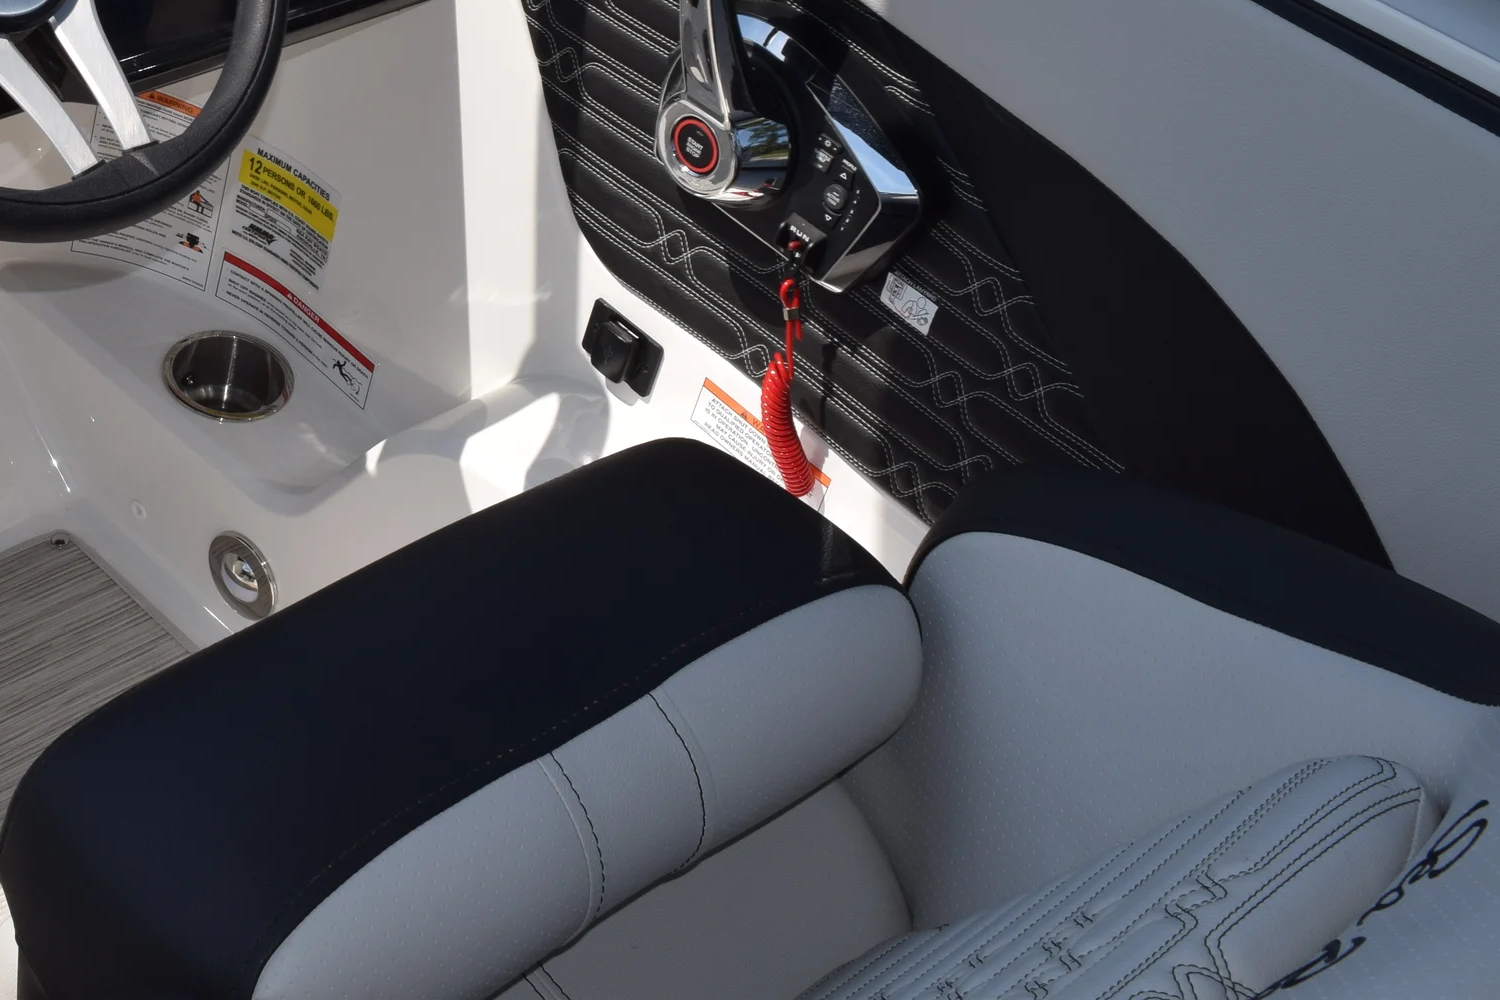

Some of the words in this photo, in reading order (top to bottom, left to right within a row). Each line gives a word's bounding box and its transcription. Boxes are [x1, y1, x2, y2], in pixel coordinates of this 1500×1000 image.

[157, 95, 194, 114] WARNING
[686, 147, 700, 159] STOP
[688, 136, 703, 150] START
[249, 156, 262, 175] 12
[264, 166, 295, 191] PERSONS
[297, 186, 306, 199] OR
[321, 206, 334, 222] LBS.
[258, 147, 292, 173] MAXIMUM
[293, 169, 330, 201] CAPACITIES
[790, 225, 810, 242] RUN
[895, 270, 913, 285] ATTACH
[913, 283, 936, 302] LANYARD
[293, 297, 320, 323] DANGER
[707, 401, 715, 411] TO
[716, 408, 744, 435] QUALIFIED
[712, 397, 733, 418] ATTACH
[733, 415, 751, 432] SHUT
[749, 428, 767, 445] DOWN
[717, 418, 751, 447] OPERATION.
[704, 421, 720, 437] READ
[720, 435, 744, 457] OWNERS
[715, 424, 728, 436] MAY
[727, 434, 747, 452] CAUSE
[746, 450, 767, 469] INJURY
